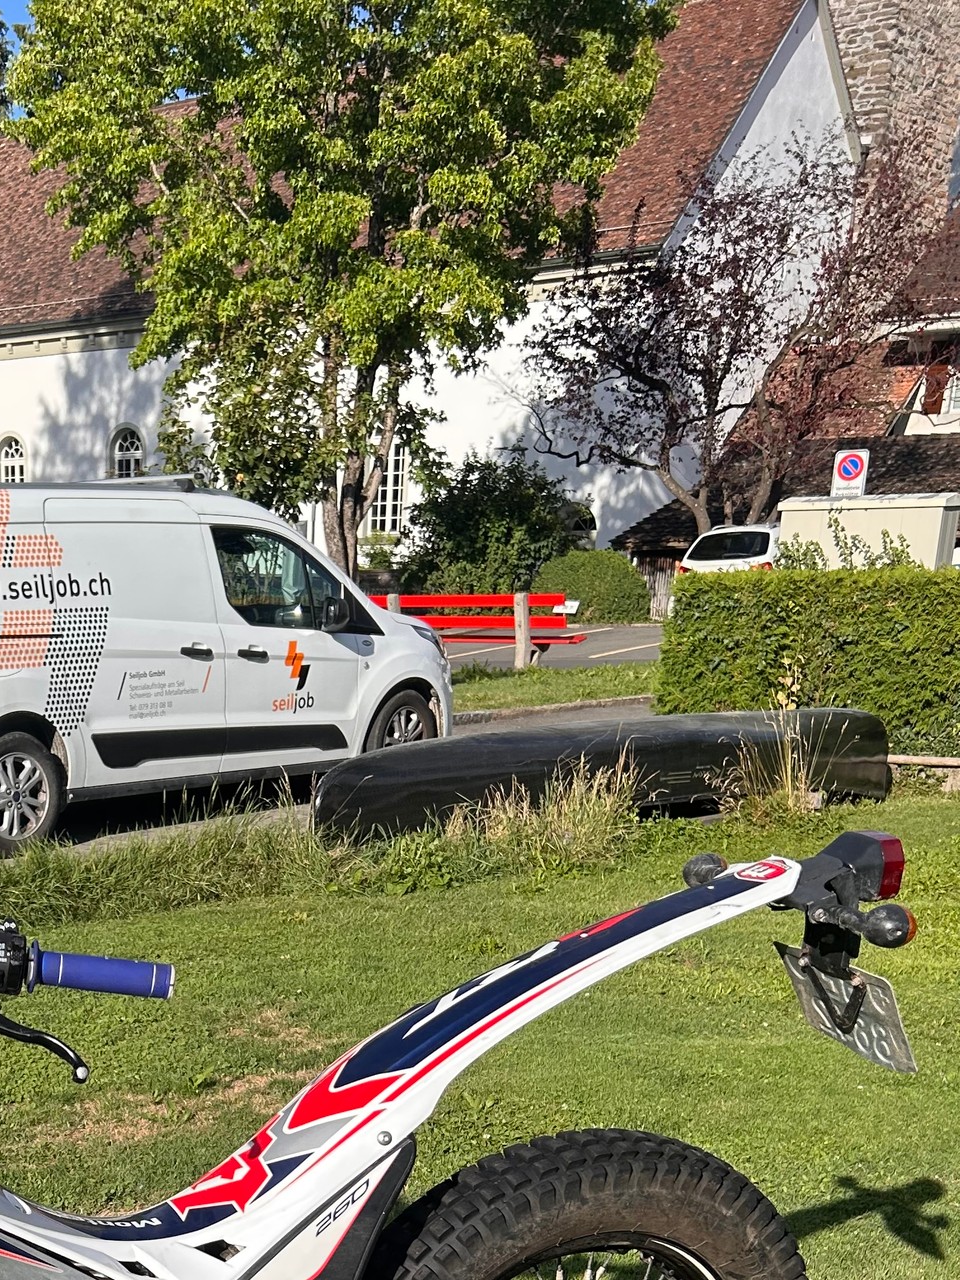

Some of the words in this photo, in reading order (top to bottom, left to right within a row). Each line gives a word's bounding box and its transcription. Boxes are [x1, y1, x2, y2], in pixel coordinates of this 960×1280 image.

[148, 670, 166, 678] GmbH
[271, 691, 315, 714] seiljob
[315, 1178, 370, 1238] 260
